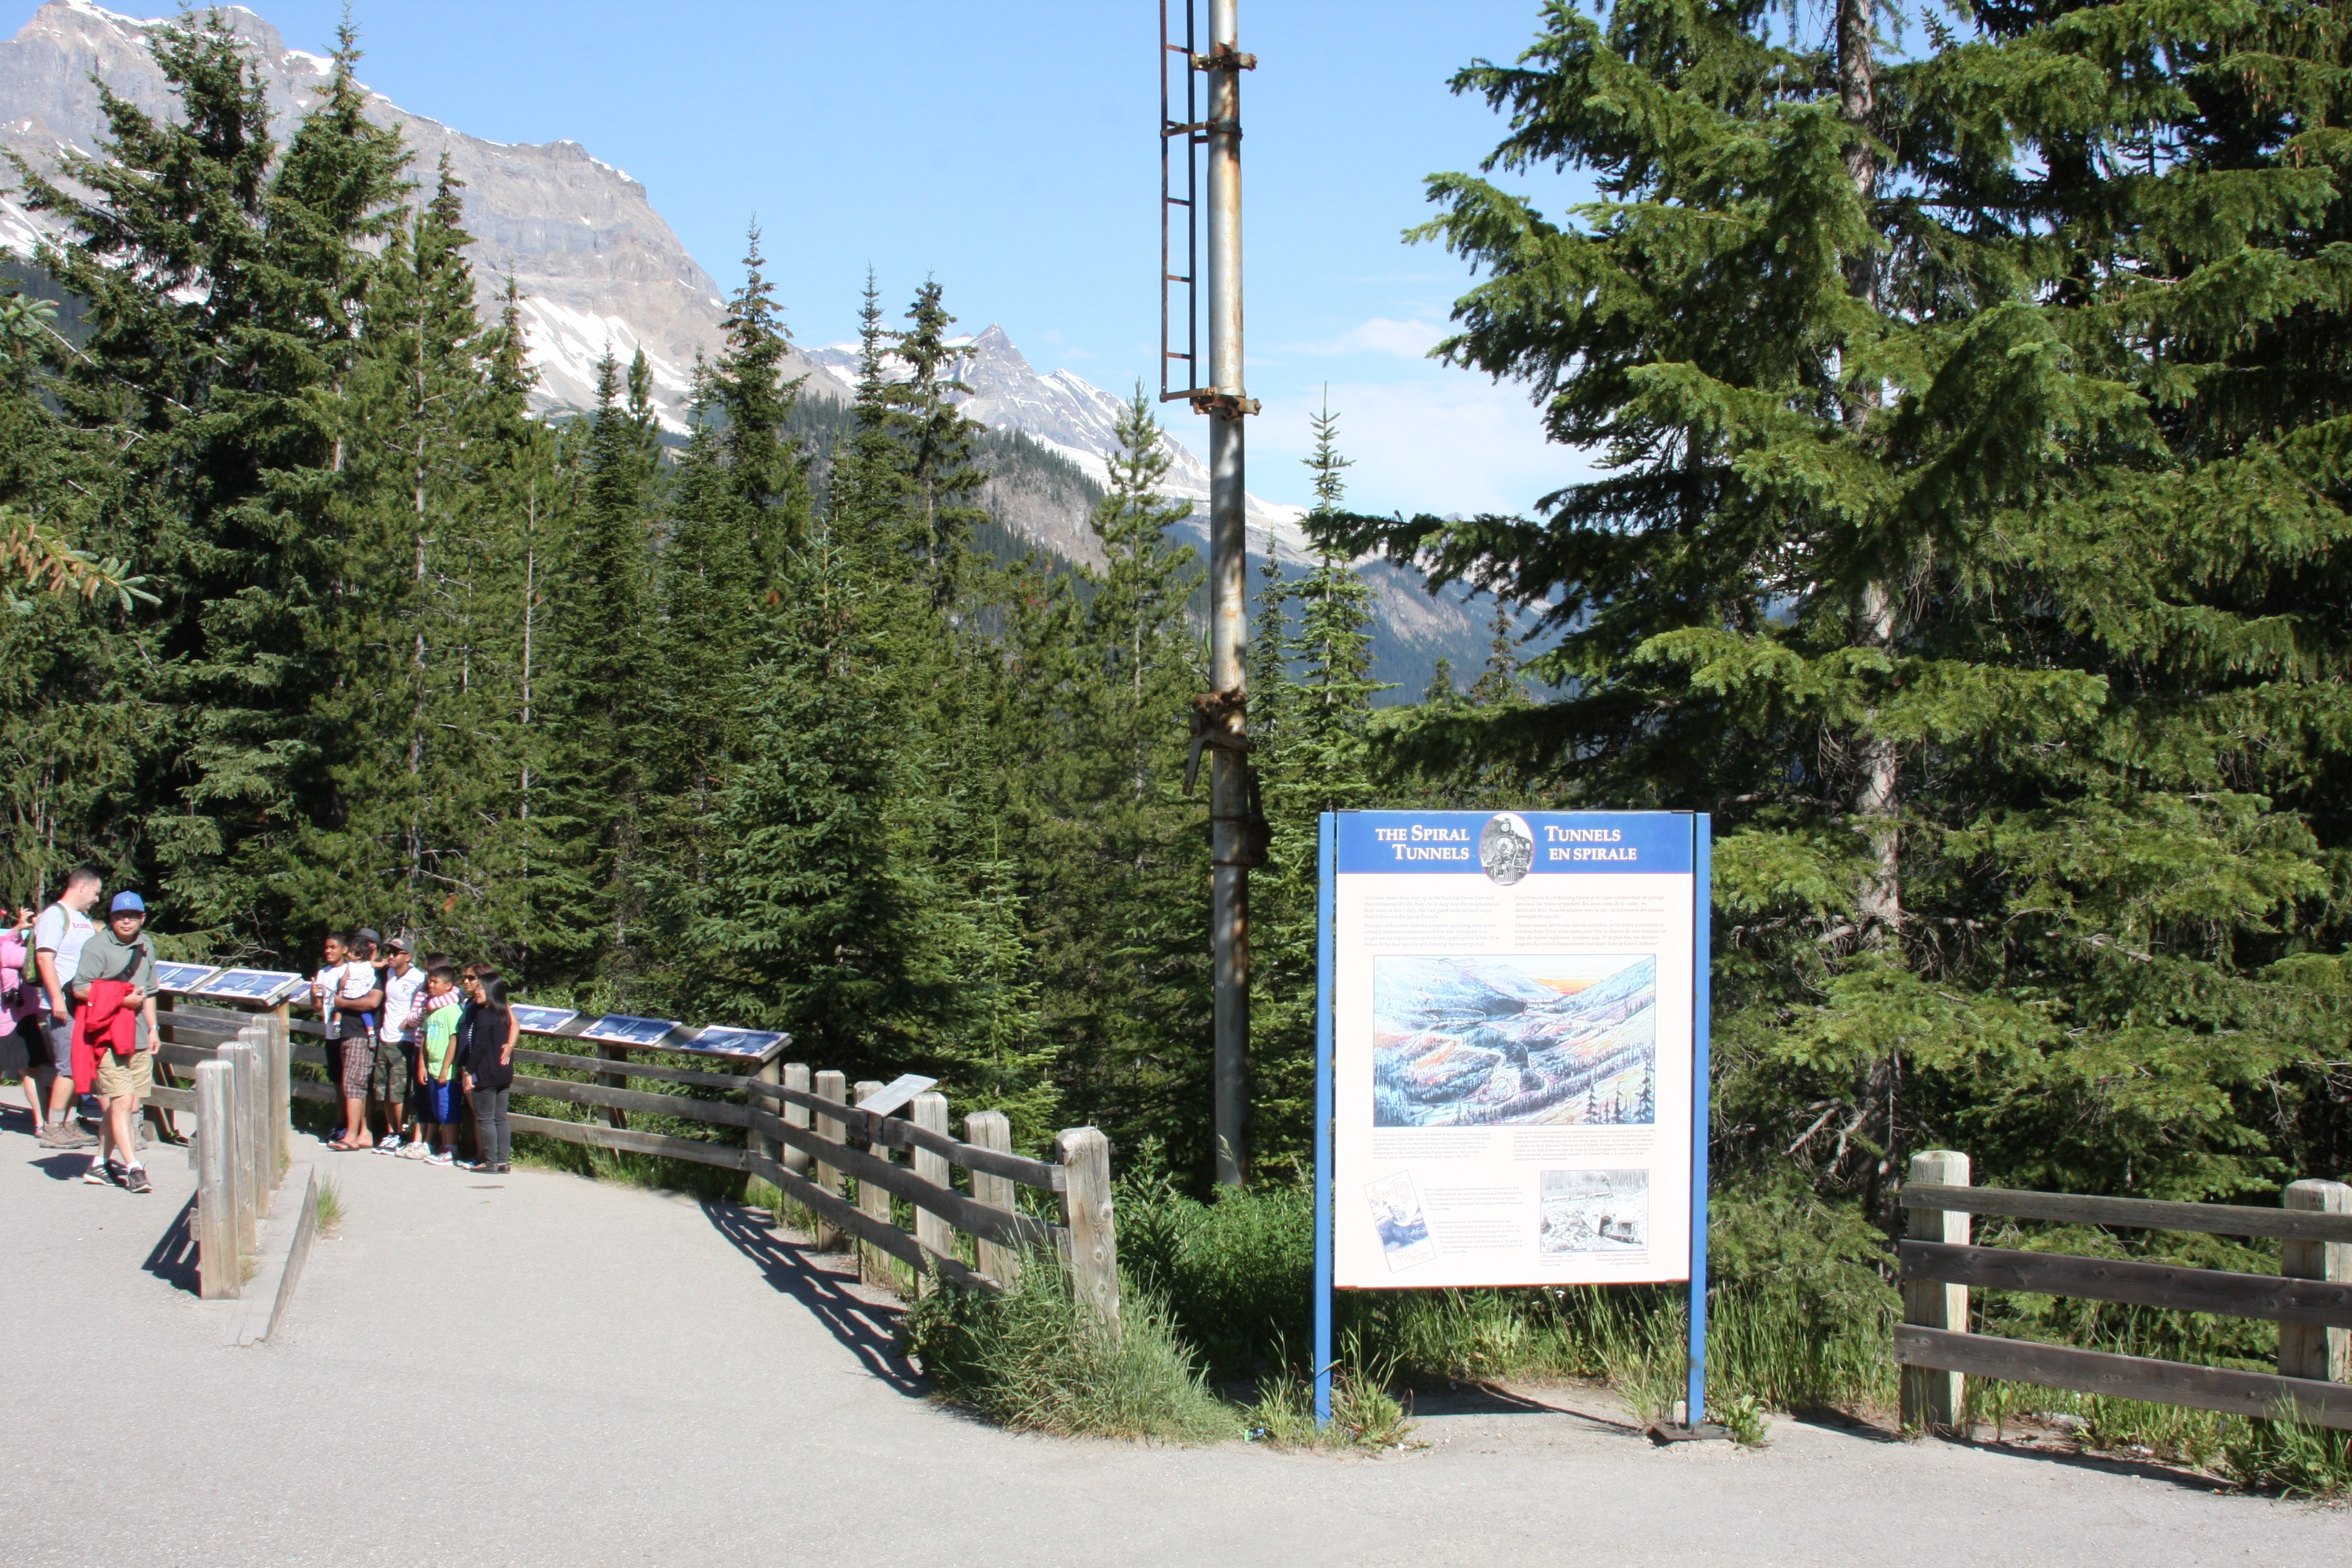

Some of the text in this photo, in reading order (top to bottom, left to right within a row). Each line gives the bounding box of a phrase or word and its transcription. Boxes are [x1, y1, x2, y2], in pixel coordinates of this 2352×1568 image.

[1375, 825, 1470, 841] THE SPIRAL
[1544, 825, 1622, 842] TUNNELS
[1392, 843, 1470, 860] TUNNELS
[1549, 848, 1637, 860] EN SPIRALE
